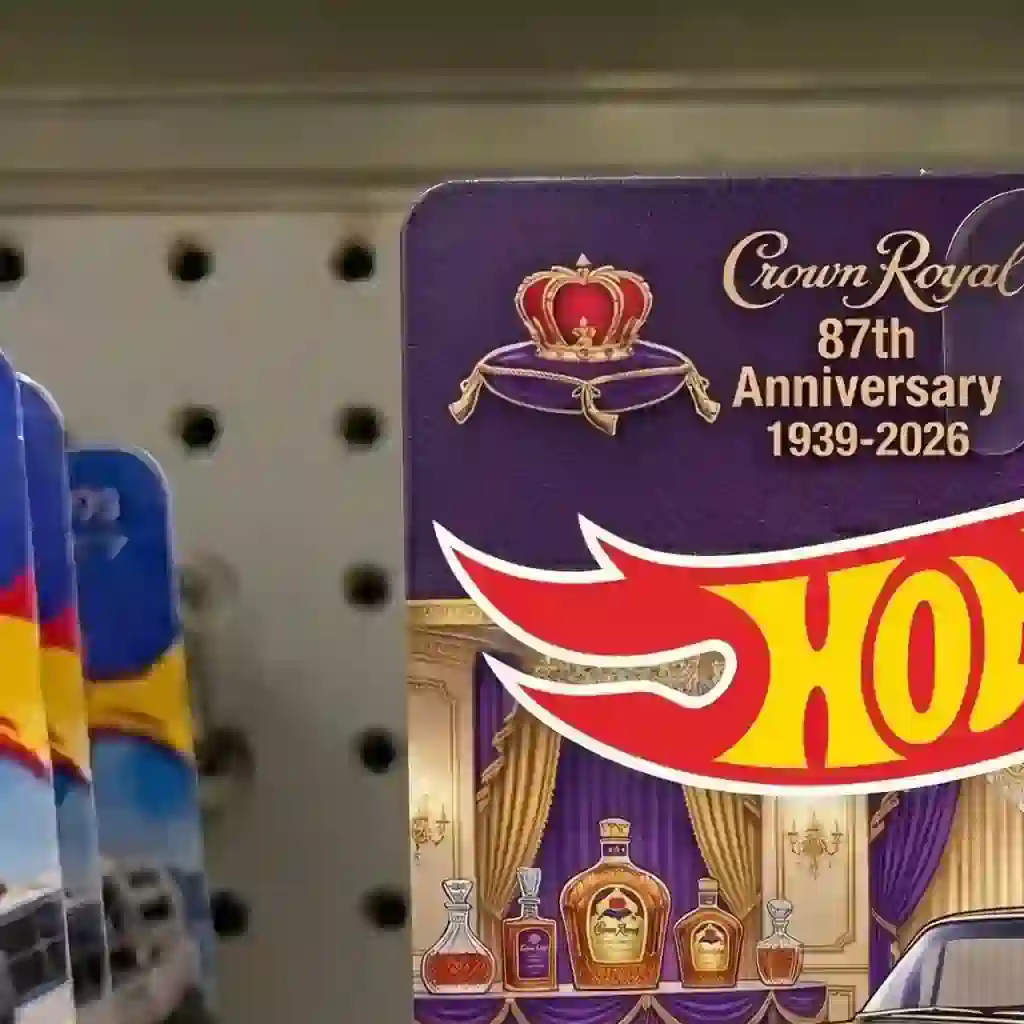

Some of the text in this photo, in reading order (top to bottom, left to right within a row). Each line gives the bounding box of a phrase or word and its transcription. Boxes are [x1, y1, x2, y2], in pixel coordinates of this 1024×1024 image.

[723, 230, 869, 309] Crown
[817, 317, 915, 359] 87th
[732, 366, 1002, 416] Anniversary
[766, 420, 970, 457] 1939-2026
